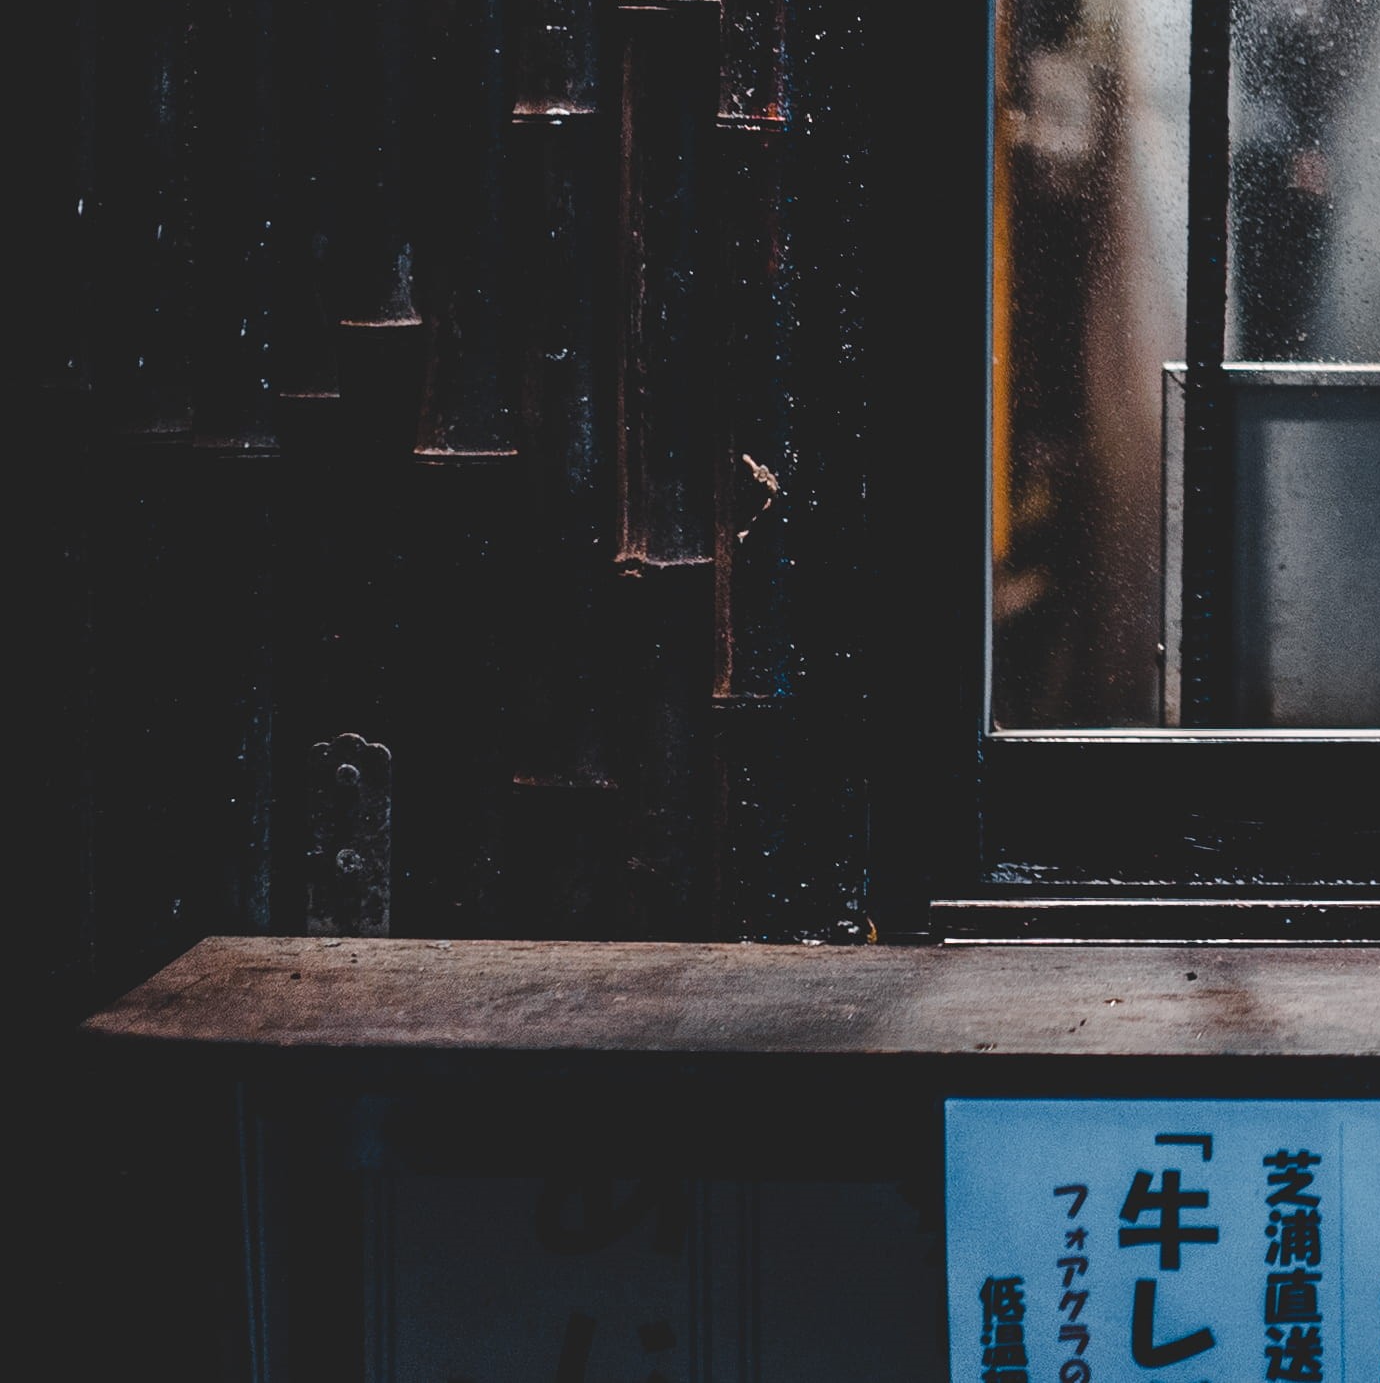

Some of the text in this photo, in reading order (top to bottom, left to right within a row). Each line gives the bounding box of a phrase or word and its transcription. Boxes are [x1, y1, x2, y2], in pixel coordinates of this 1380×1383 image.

[980, 1275, 1028, 1383] 低温
[1118, 1132, 1219, 1369] 「牛レ
[1263, 1148, 1324, 1383] 芝浦直送
